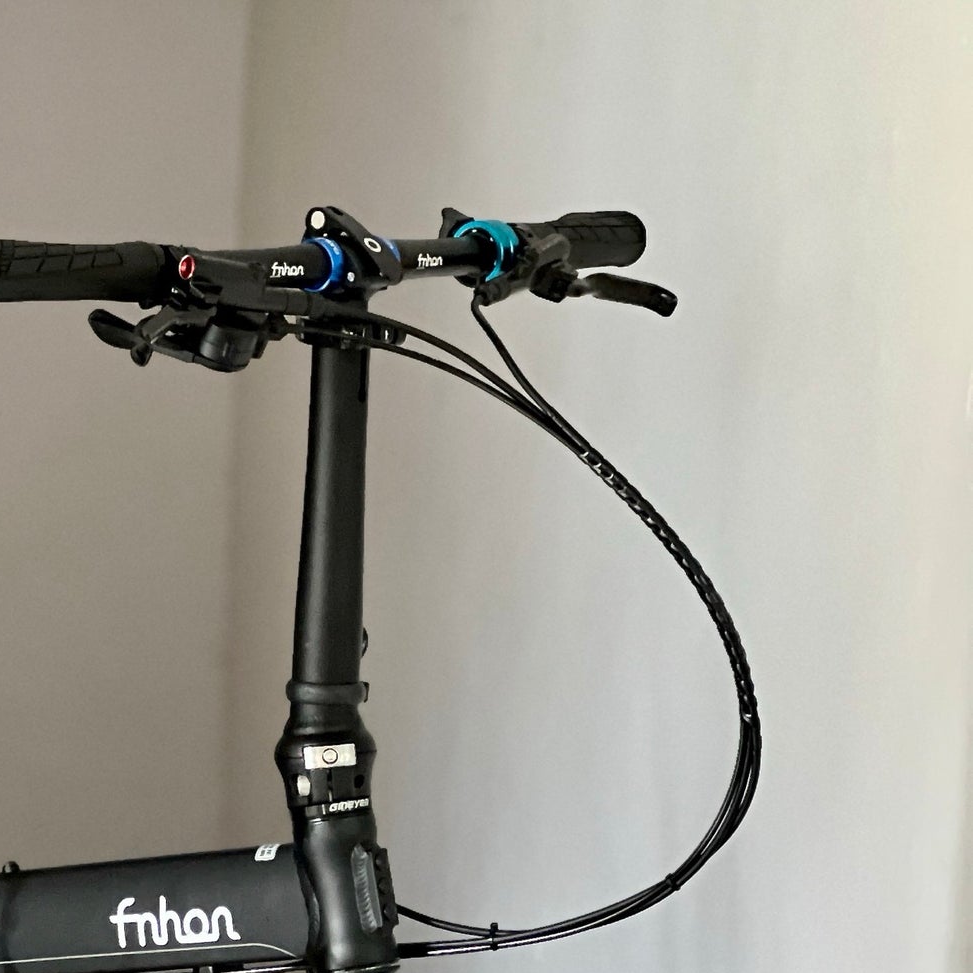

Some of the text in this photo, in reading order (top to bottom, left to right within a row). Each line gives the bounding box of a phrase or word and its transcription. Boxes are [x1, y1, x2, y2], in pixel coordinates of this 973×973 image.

[417, 253, 443, 268] fnhon
[269, 262, 305, 278] fnhon
[109, 895, 241, 949] fnhon
